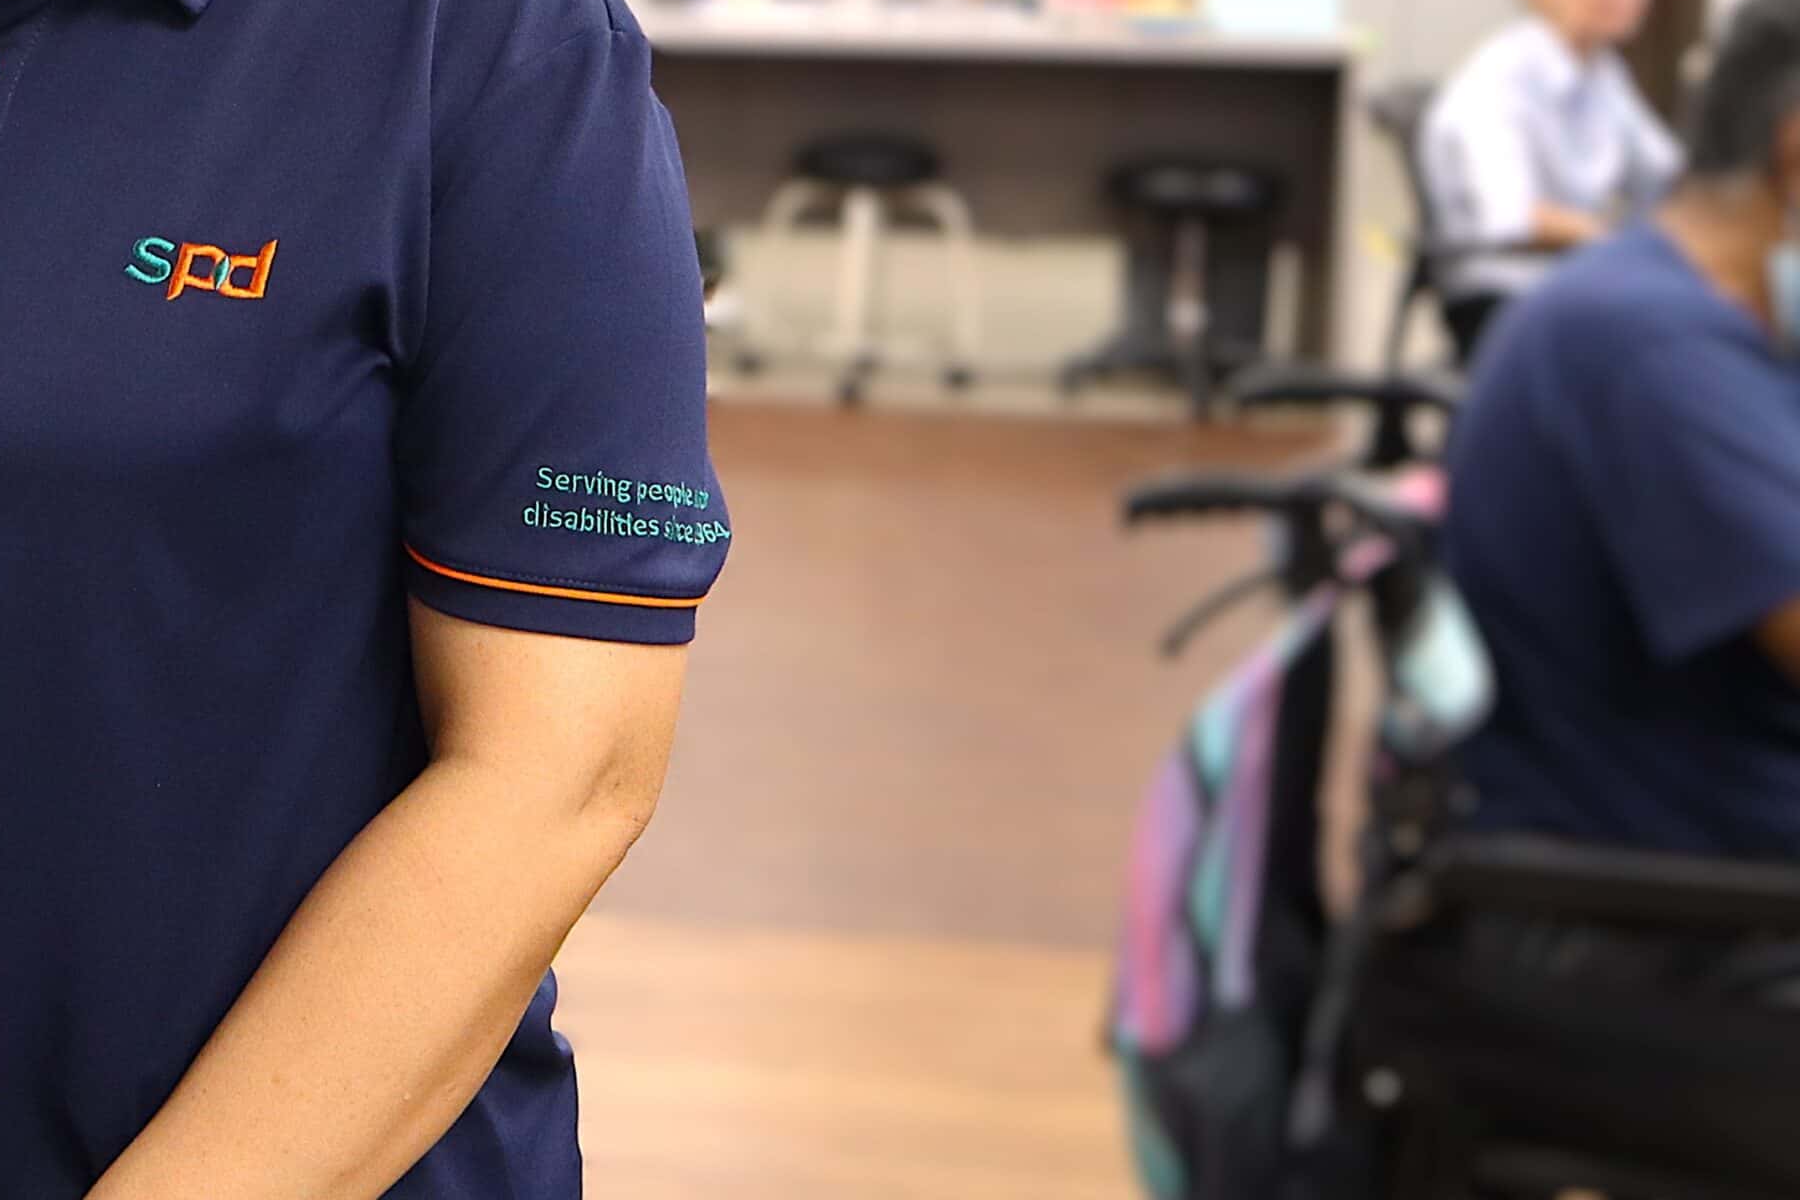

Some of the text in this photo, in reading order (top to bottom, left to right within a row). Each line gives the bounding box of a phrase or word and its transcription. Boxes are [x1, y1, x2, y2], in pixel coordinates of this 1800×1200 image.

[125, 236, 278, 301] spd
[536, 467, 632, 502] Serving
[636, 481, 693, 508] people
[523, 501, 660, 537] disabilities
